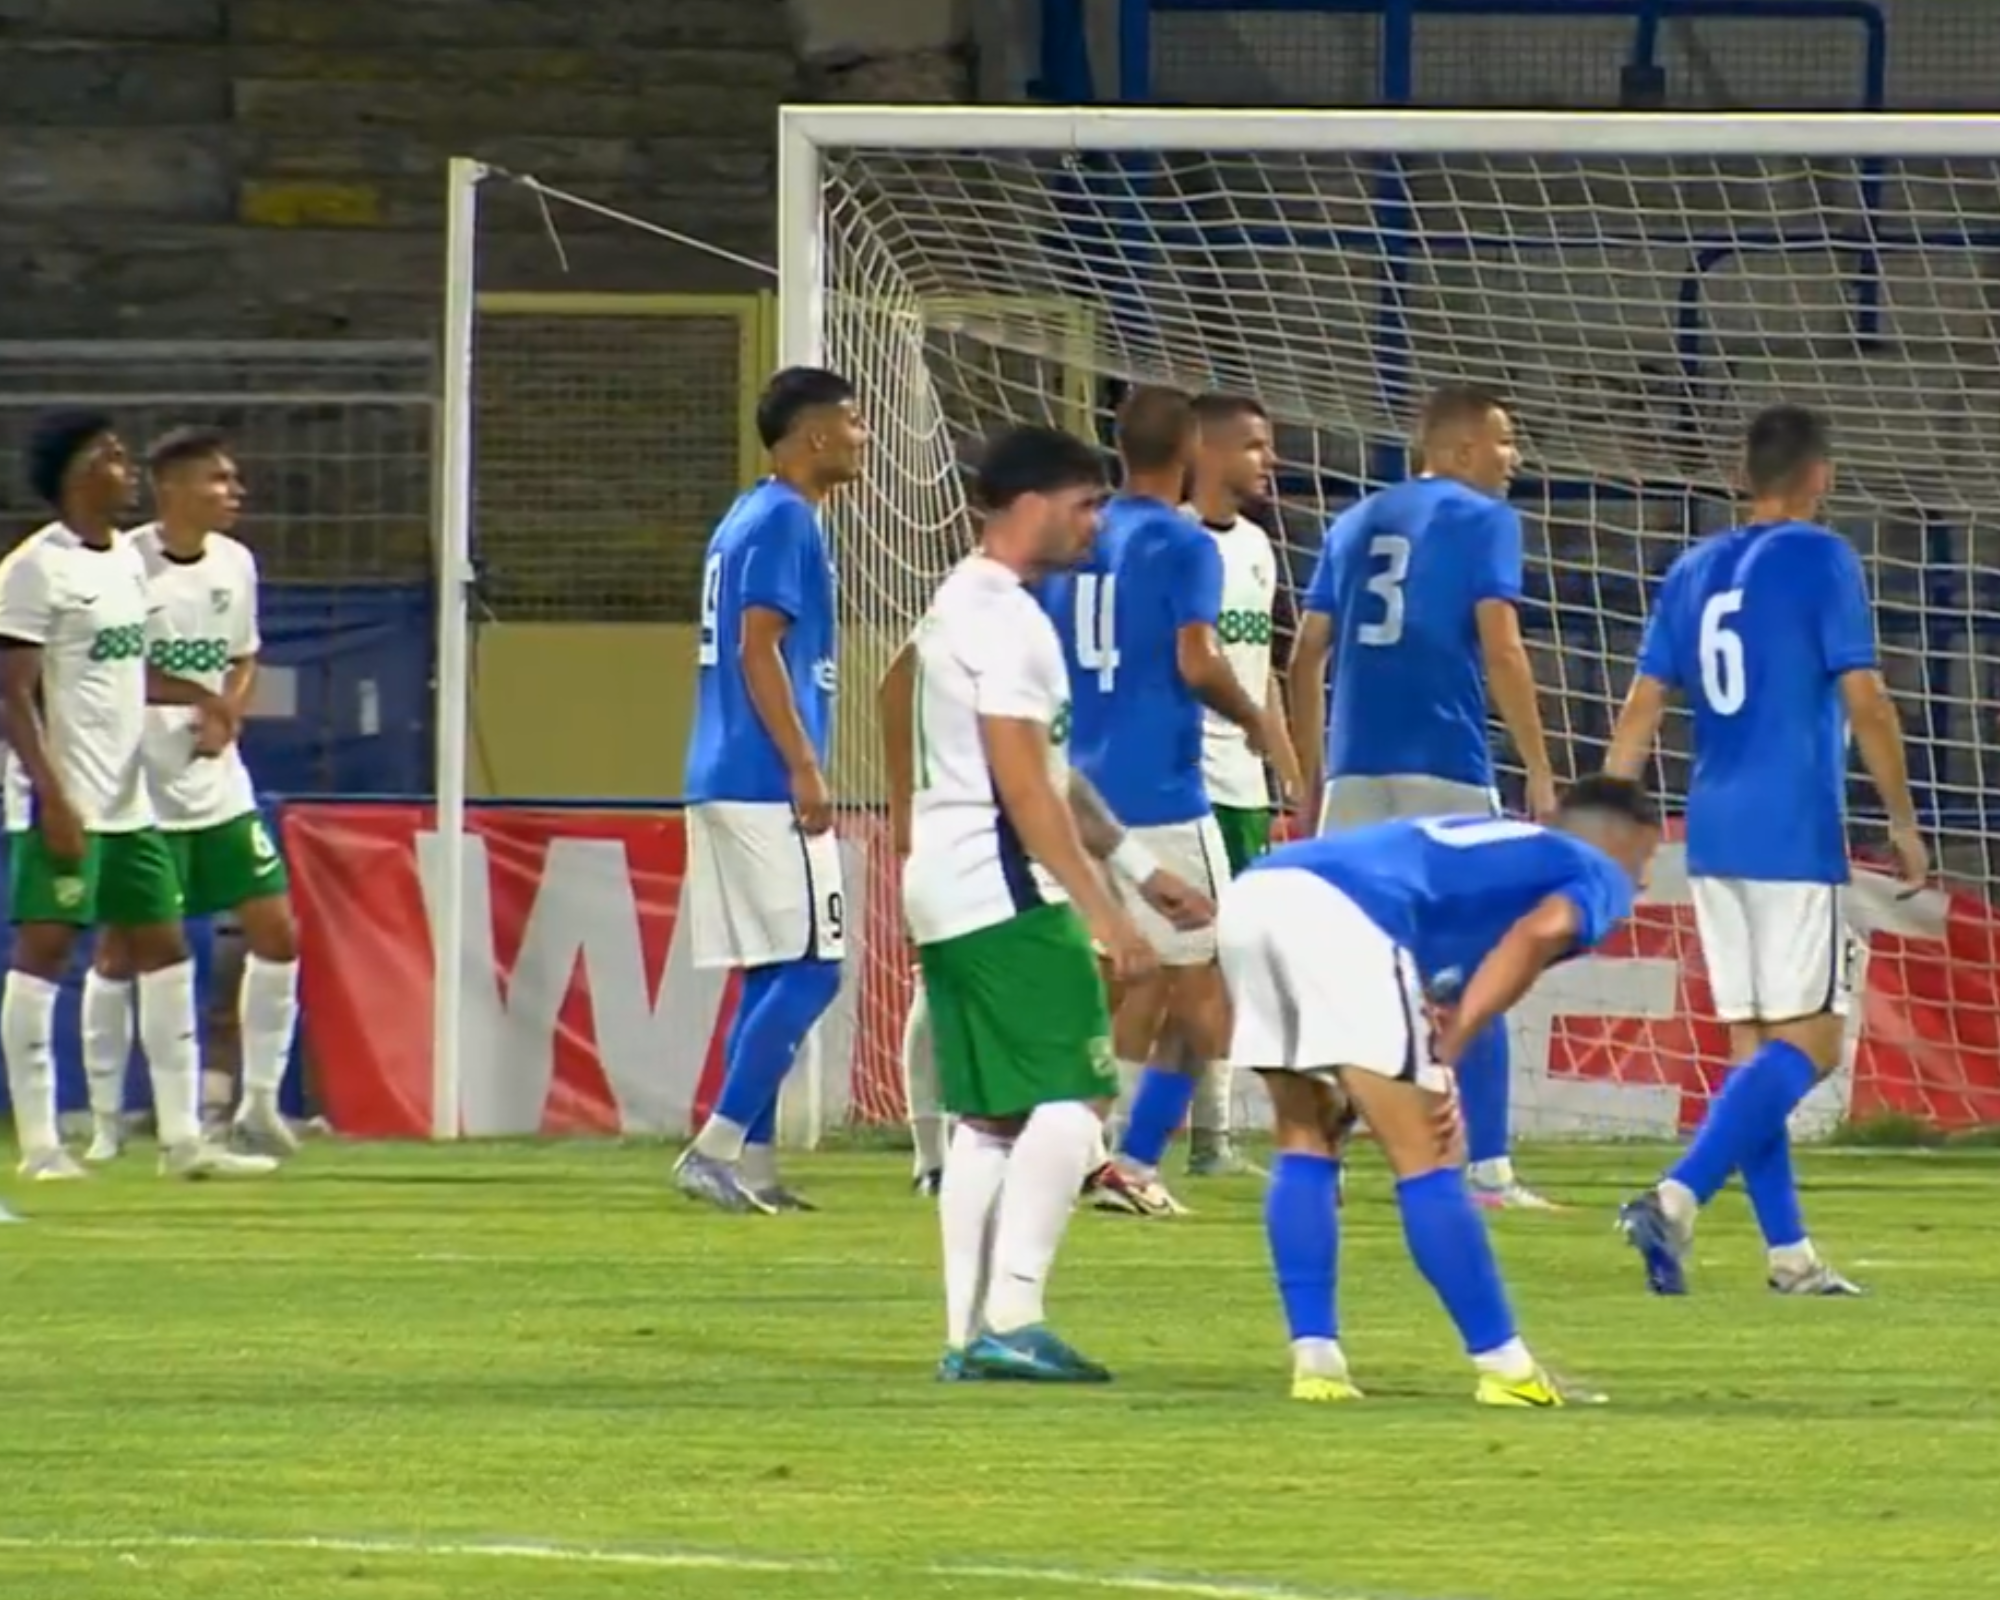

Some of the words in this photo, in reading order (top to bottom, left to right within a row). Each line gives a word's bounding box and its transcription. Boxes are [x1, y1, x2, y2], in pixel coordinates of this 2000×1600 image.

[1076, 573, 1120, 692] 4
[1357, 534, 1411, 646] 3
[1699, 588, 1746, 716] 6
[828, 892, 843, 939] 9
